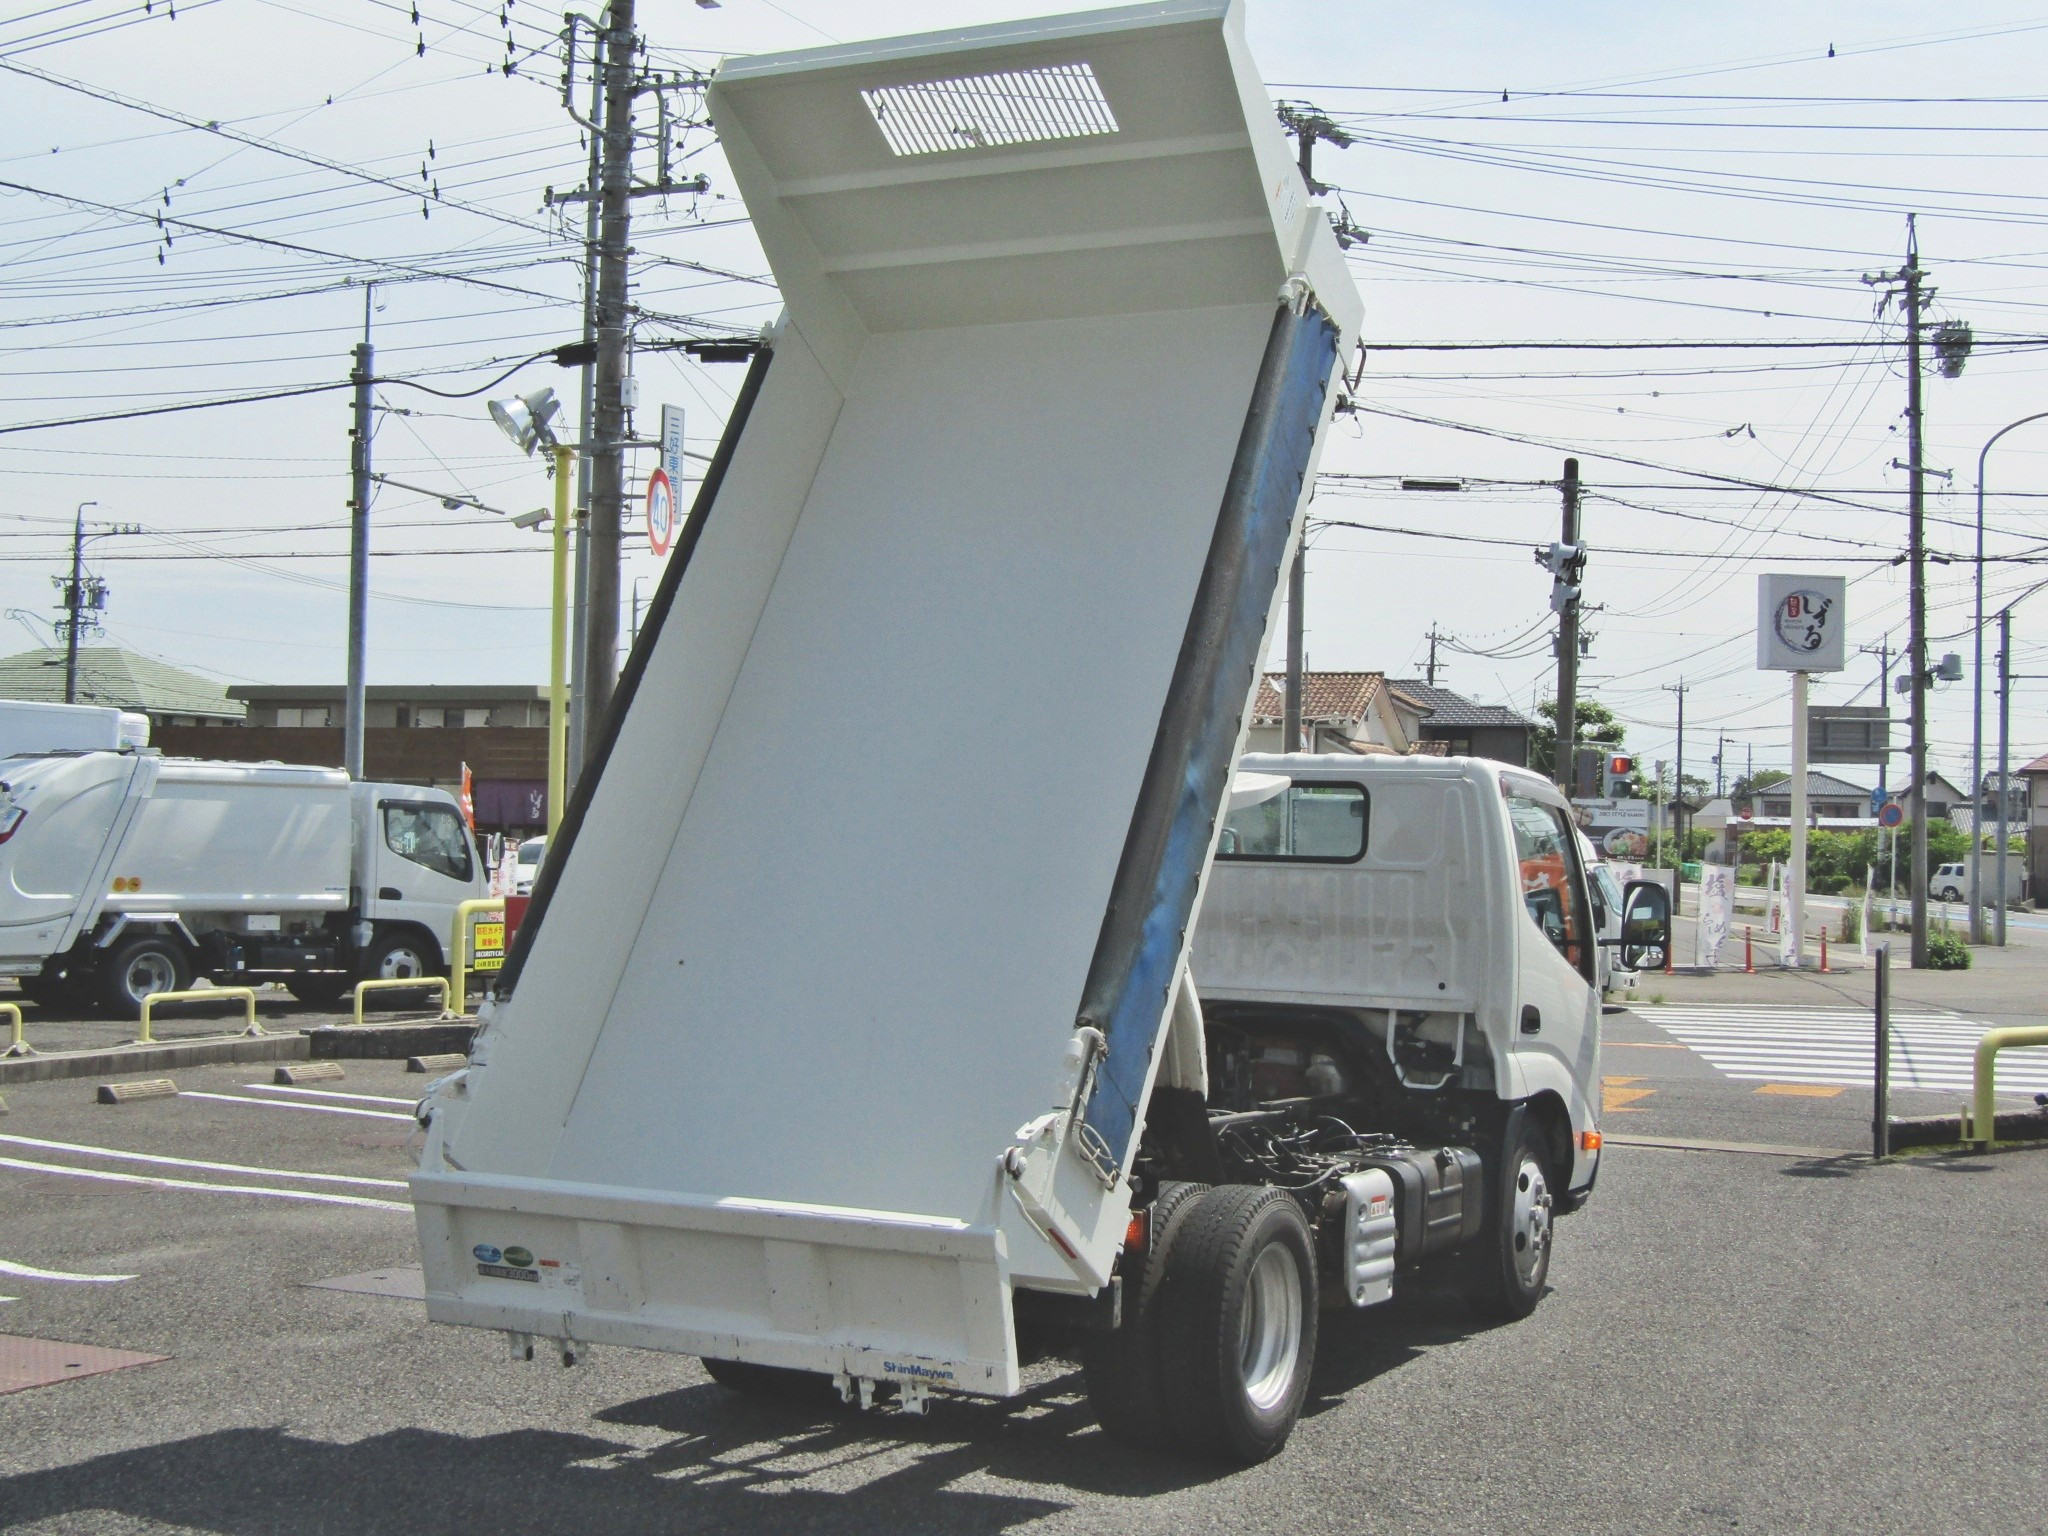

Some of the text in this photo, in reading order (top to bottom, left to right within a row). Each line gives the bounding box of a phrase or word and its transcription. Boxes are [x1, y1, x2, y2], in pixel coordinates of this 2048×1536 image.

[653, 493, 668, 532] 40
[477, 926, 502, 935] 防犯カメラ
[883, 1361, 954, 1380] ShinMaywa
